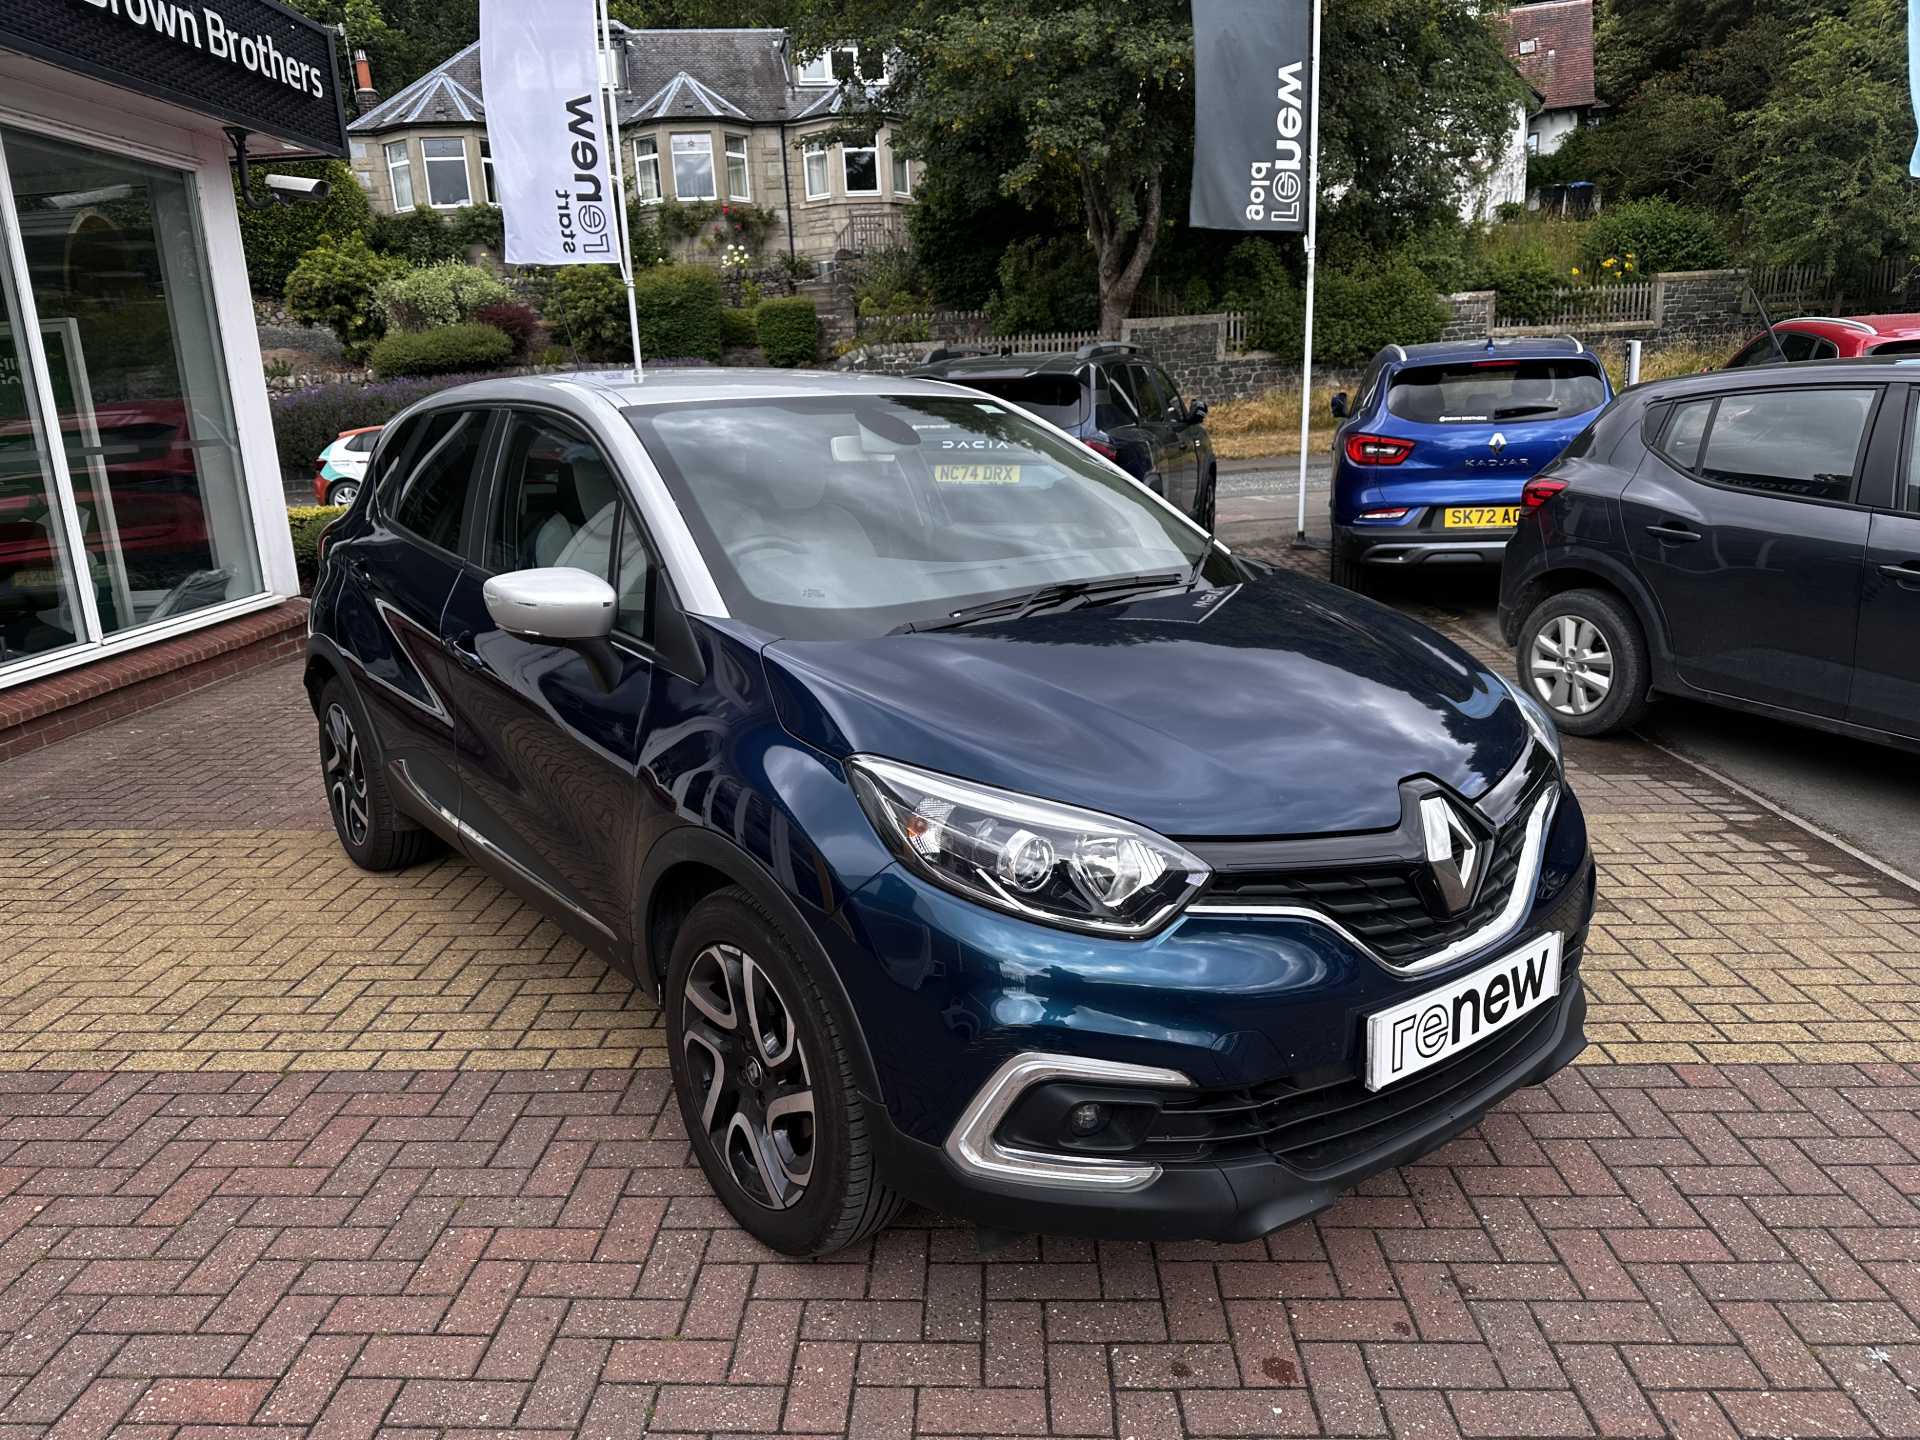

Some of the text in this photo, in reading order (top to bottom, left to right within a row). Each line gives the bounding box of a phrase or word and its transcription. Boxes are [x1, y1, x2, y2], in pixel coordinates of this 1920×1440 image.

[84, 0, 324, 98] own Brothers
[942, 440, 1009, 449] DACIA
[1464, 458, 1529, 467] KADJAR
[940, 466, 1012, 481] NC74 DRX
[1452, 508, 1497, 525] SK72
[1392, 948, 1549, 1072] renew
